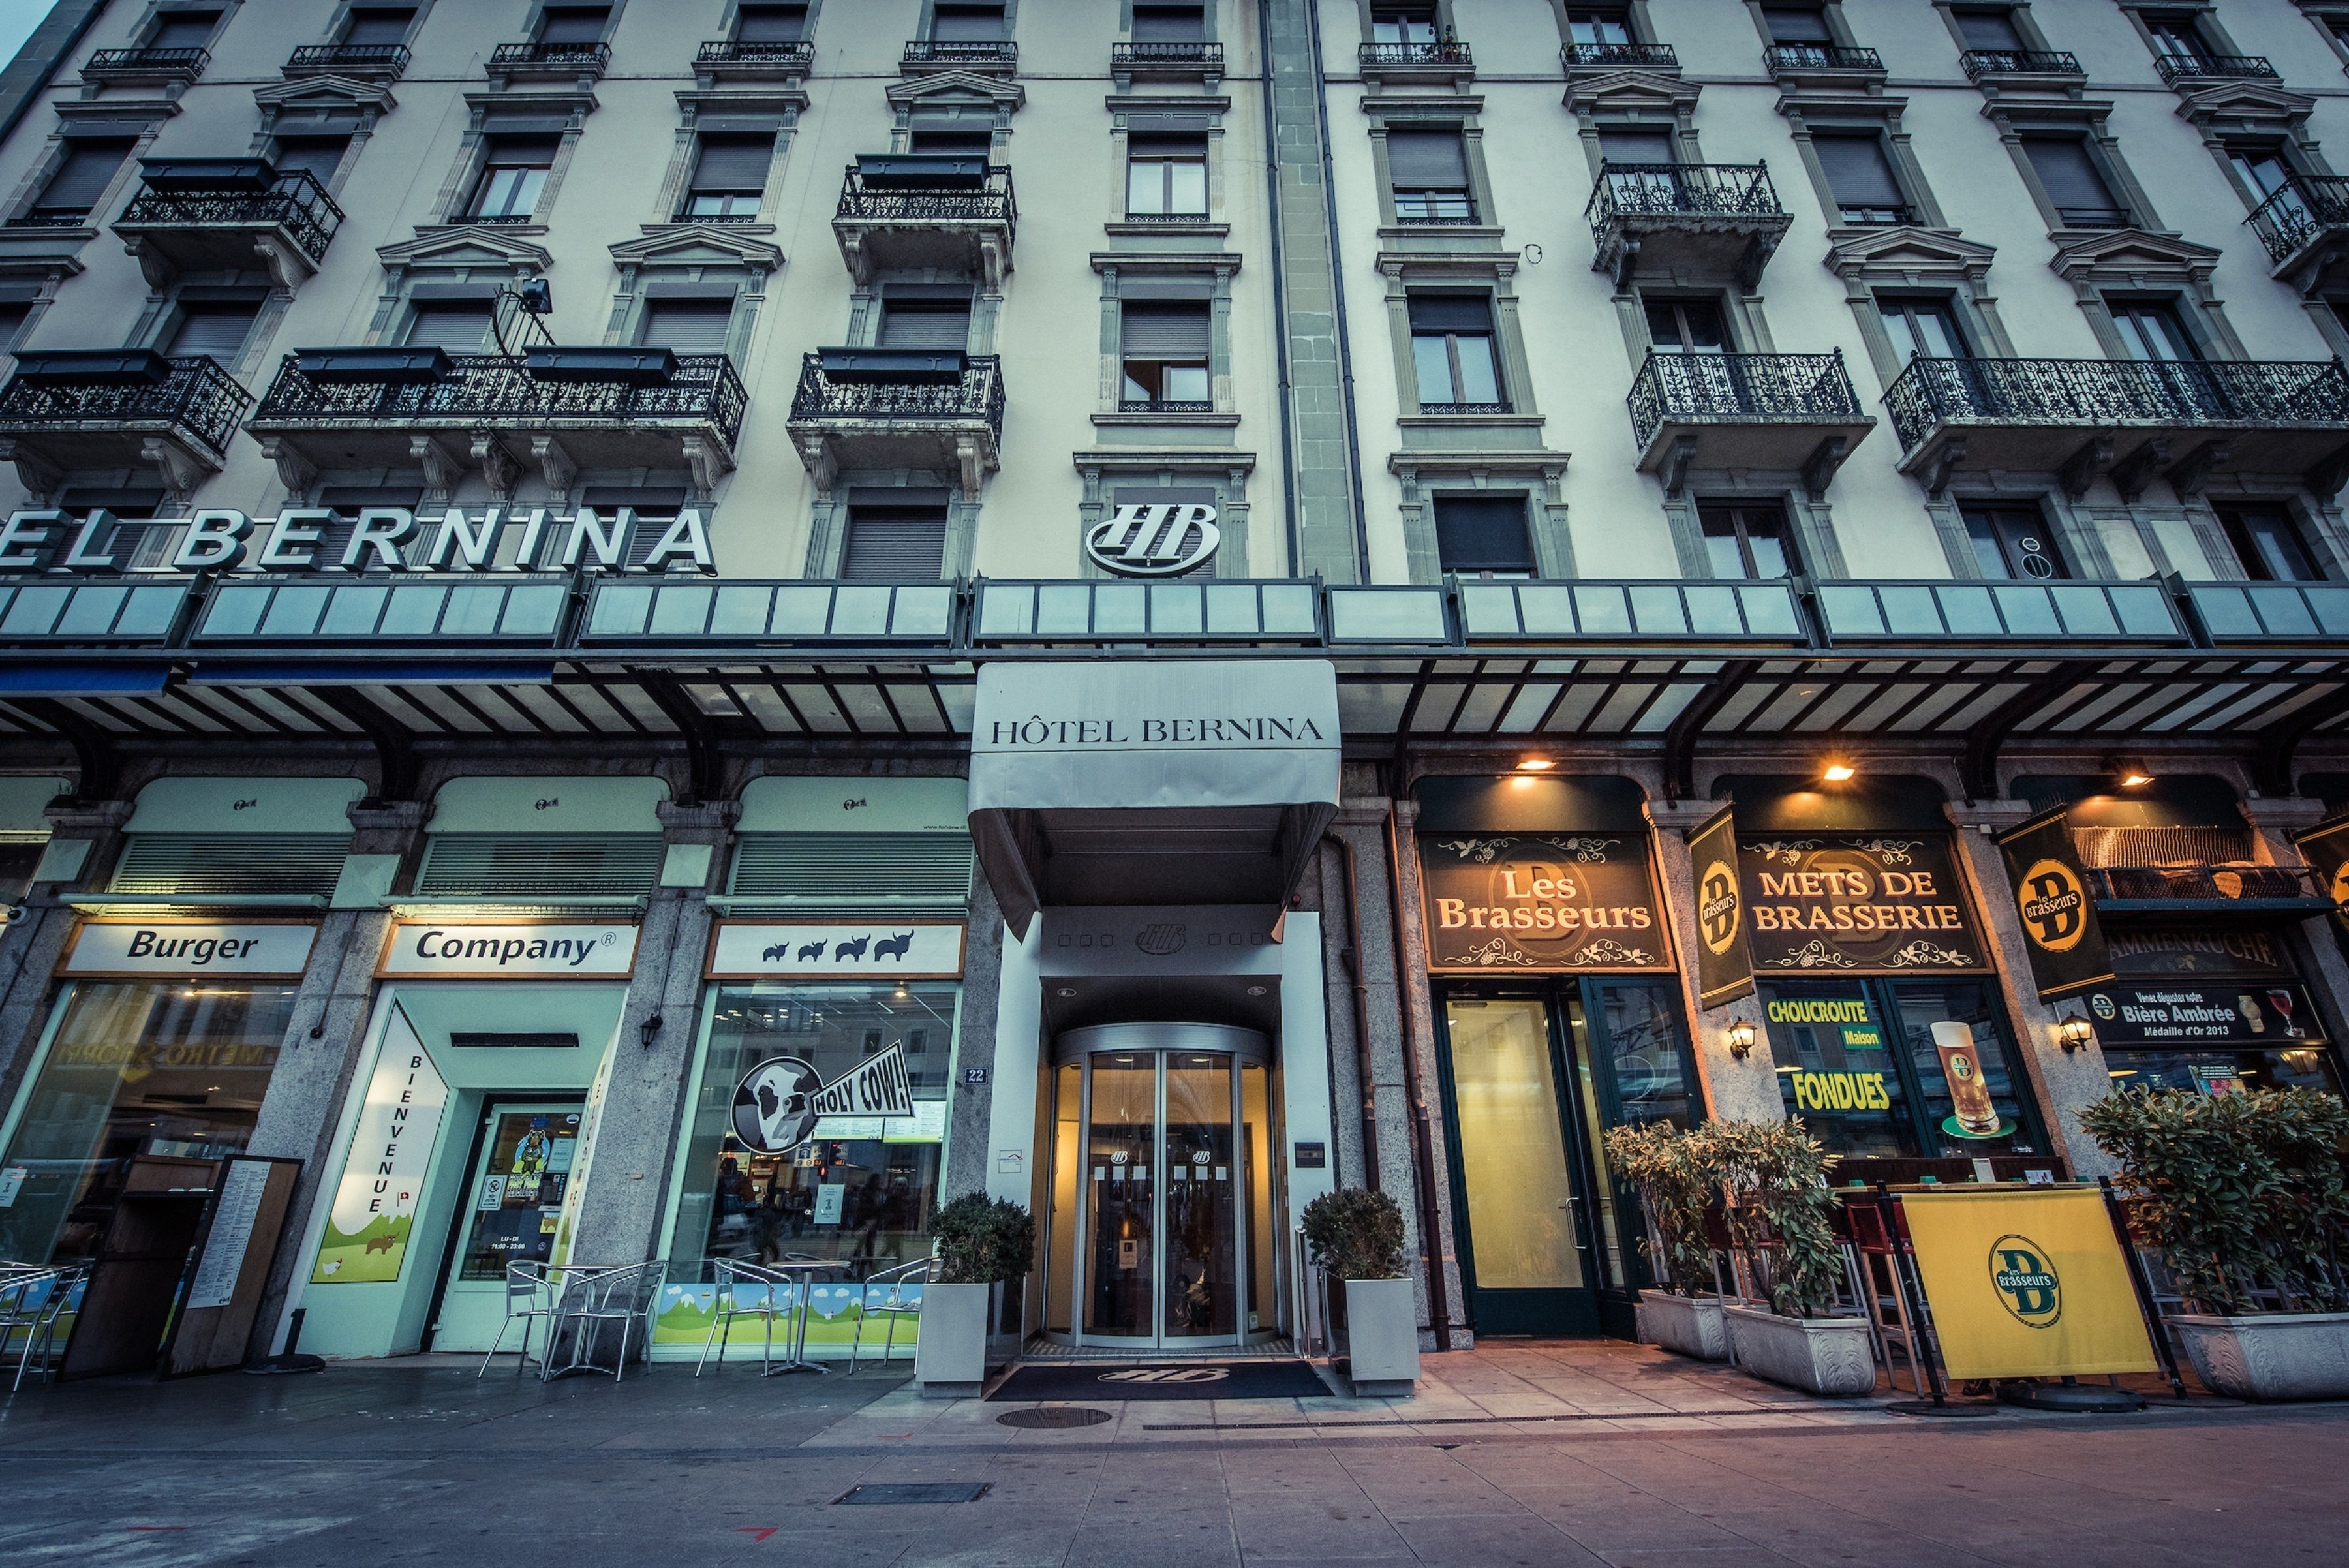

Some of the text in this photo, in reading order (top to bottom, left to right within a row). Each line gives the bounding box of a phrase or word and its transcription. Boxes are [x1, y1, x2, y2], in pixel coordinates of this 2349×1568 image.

[0, 508, 716, 573] EL BERNINA
[991, 714, 1324, 744] HÔTEL BERNINA
[1501, 870, 1577, 899] Les
[1758, 872, 1938, 897] METS DE
[1436, 898, 1651, 930] Brasseurs
[1752, 905, 1963, 931] BRASSERIE
[2025, 892, 2078, 918] Brasseurs
[127, 930, 260, 965] Burger
[1767, 1000, 1869, 1023] CHOUCROUTE
[2136, 992, 2204, 1005] Venez déguster notre
[2121, 1003, 2236, 1023] Bière Ambrée
[1843, 1030, 1879, 1045] Maison
[2144, 1026, 2230, 1036] Médaille d'Or 2013
[816, 1053, 906, 1114] HOLY COW!
[968, 1069, 984, 1083] 22
[1792, 1072, 1890, 1110] FONDUES
[369, 1056, 423, 1212] BIENVENUE
[1998, 1275, 2051, 1287] Brasseurs
[2008, 1267, 2020, 1276] Les
